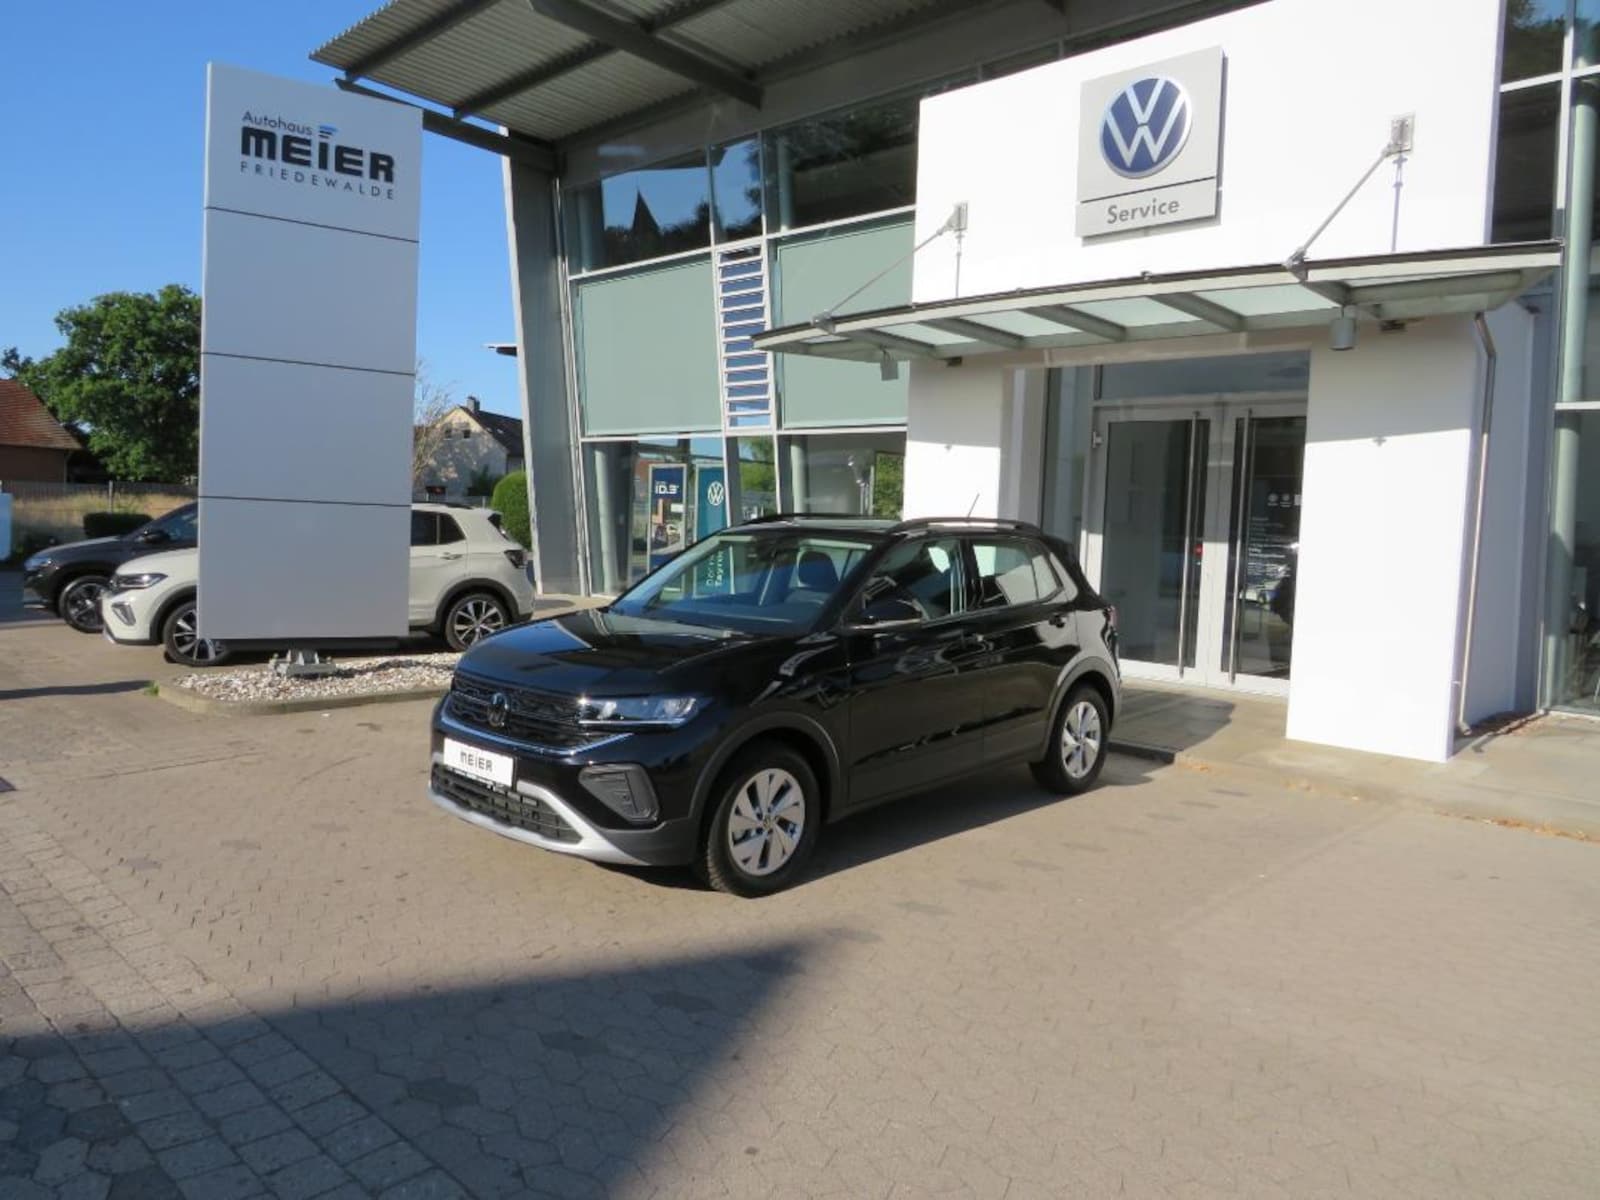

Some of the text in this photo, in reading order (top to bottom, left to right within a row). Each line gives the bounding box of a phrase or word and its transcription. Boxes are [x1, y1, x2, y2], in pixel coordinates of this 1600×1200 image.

[241, 111, 313, 136] Autohaus
[240, 161, 395, 200] FRIEDEWALDE
[1107, 198, 1180, 224] Service
